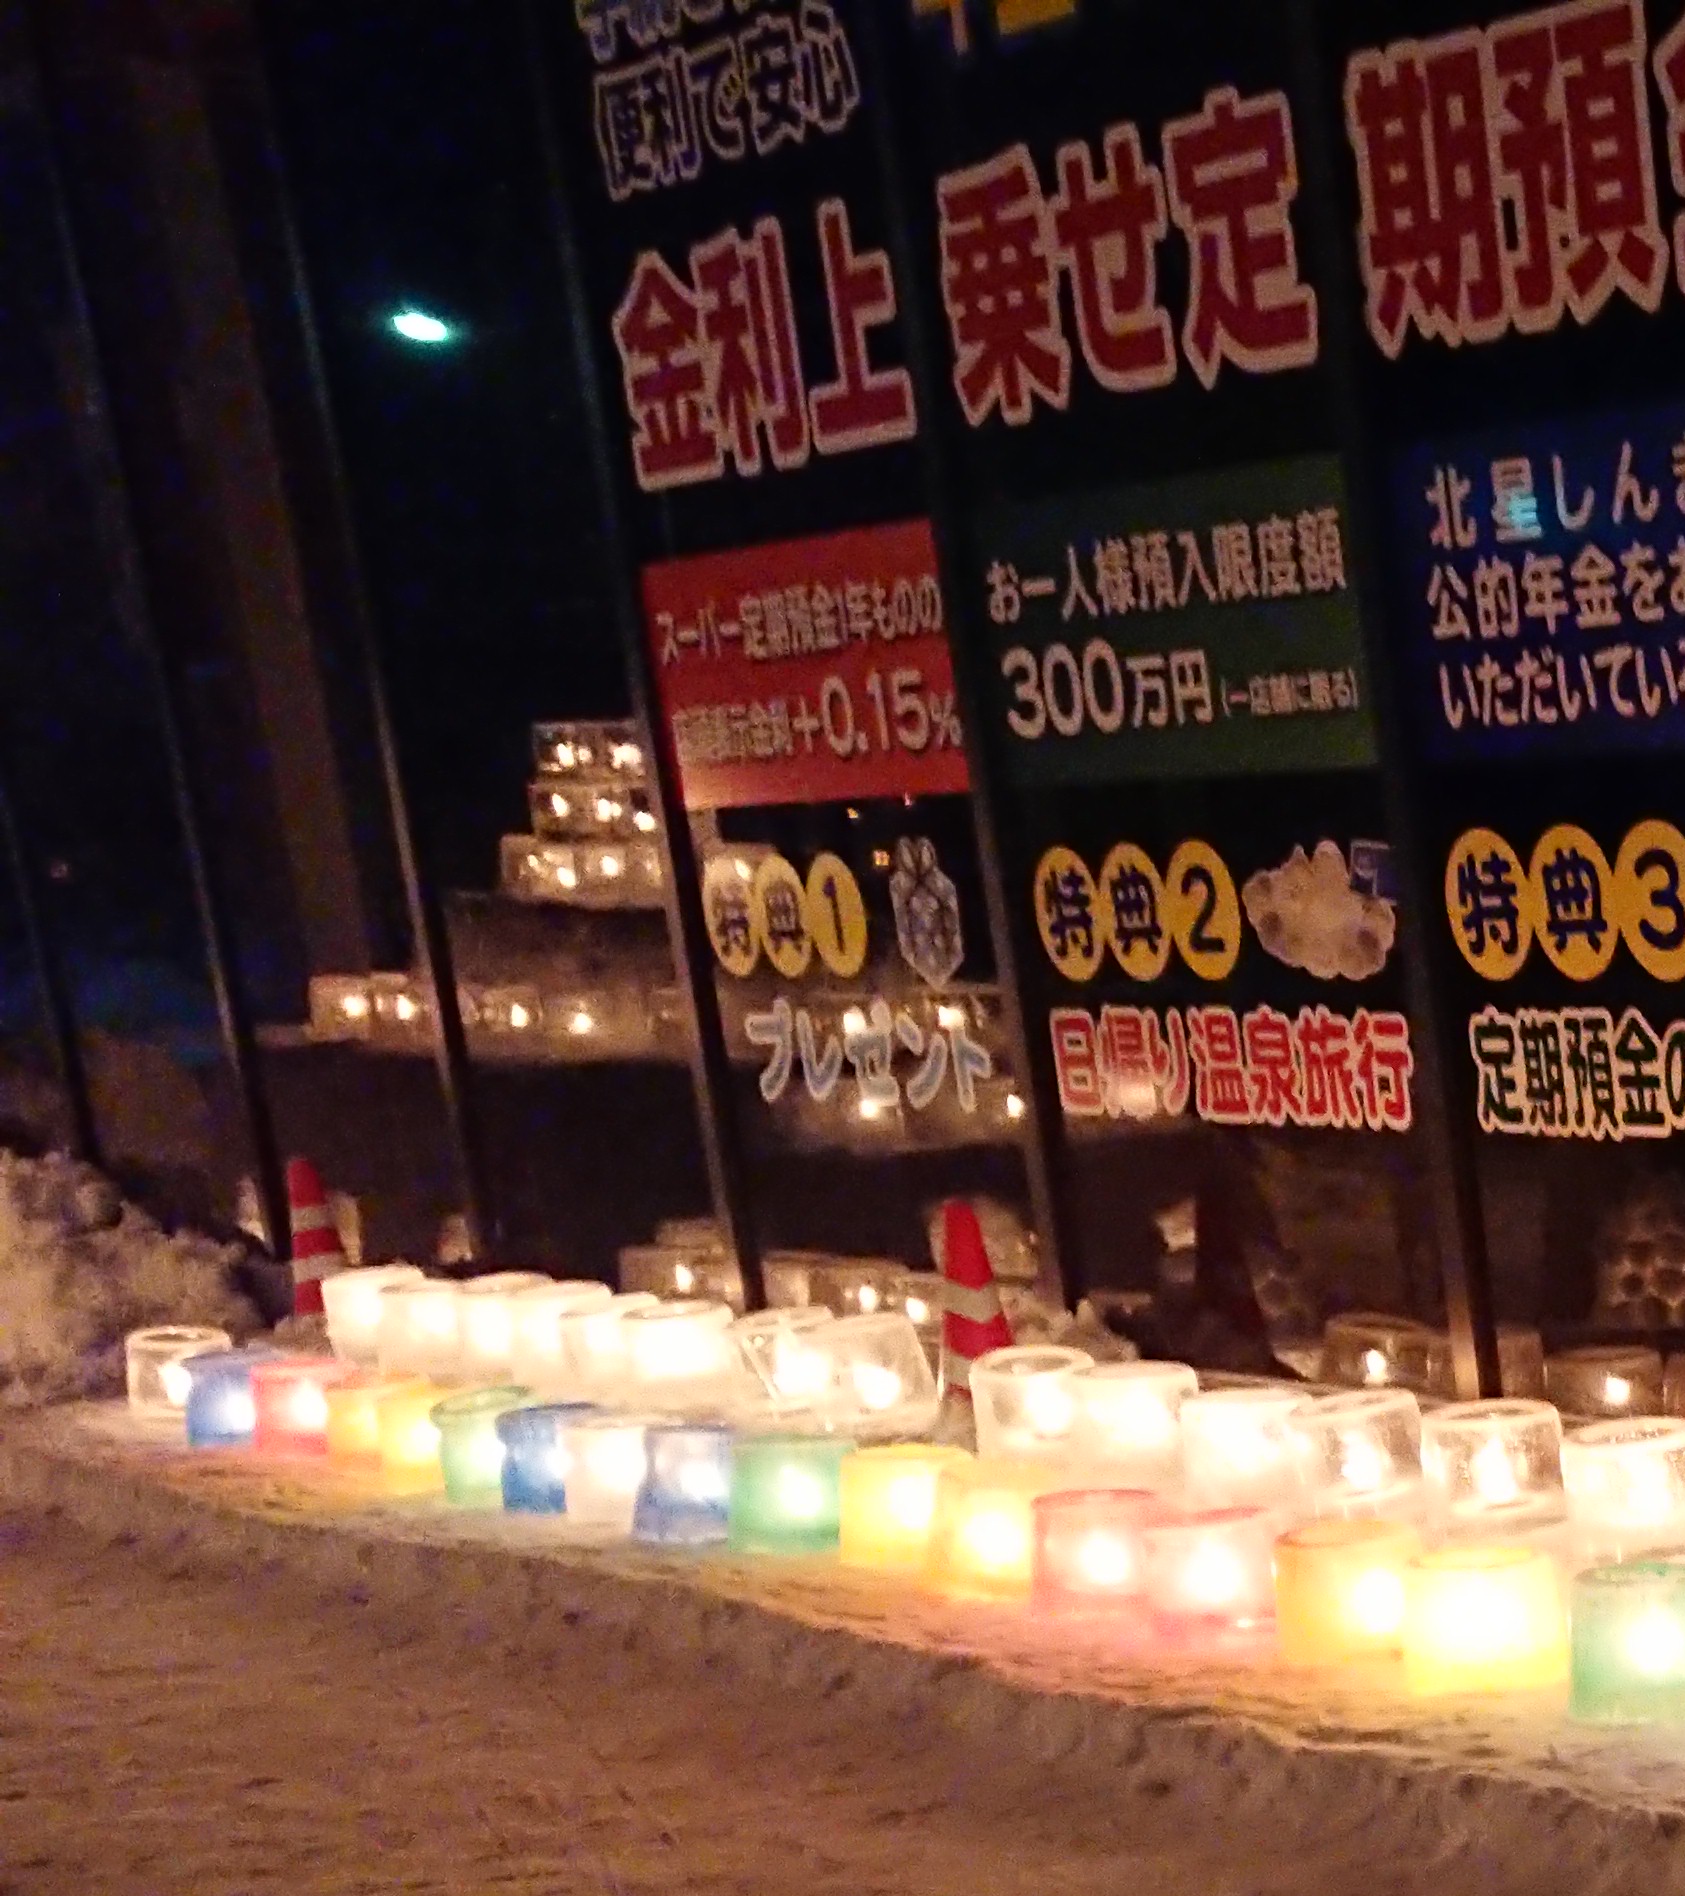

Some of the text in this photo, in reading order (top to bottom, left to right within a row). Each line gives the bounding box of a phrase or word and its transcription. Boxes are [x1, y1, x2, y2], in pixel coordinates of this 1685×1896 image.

[593, 2, 858, 201] 便利で安心
[614, 198, 917, 491] 金利上
[937, 84, 1318, 428] 乗せ定
[986, 505, 1348, 625] お一人様預入限度額
[743, 995, 993, 1113] プレゼント
[1049, 1003, 1414, 1132] 日帰り温泉旅行
